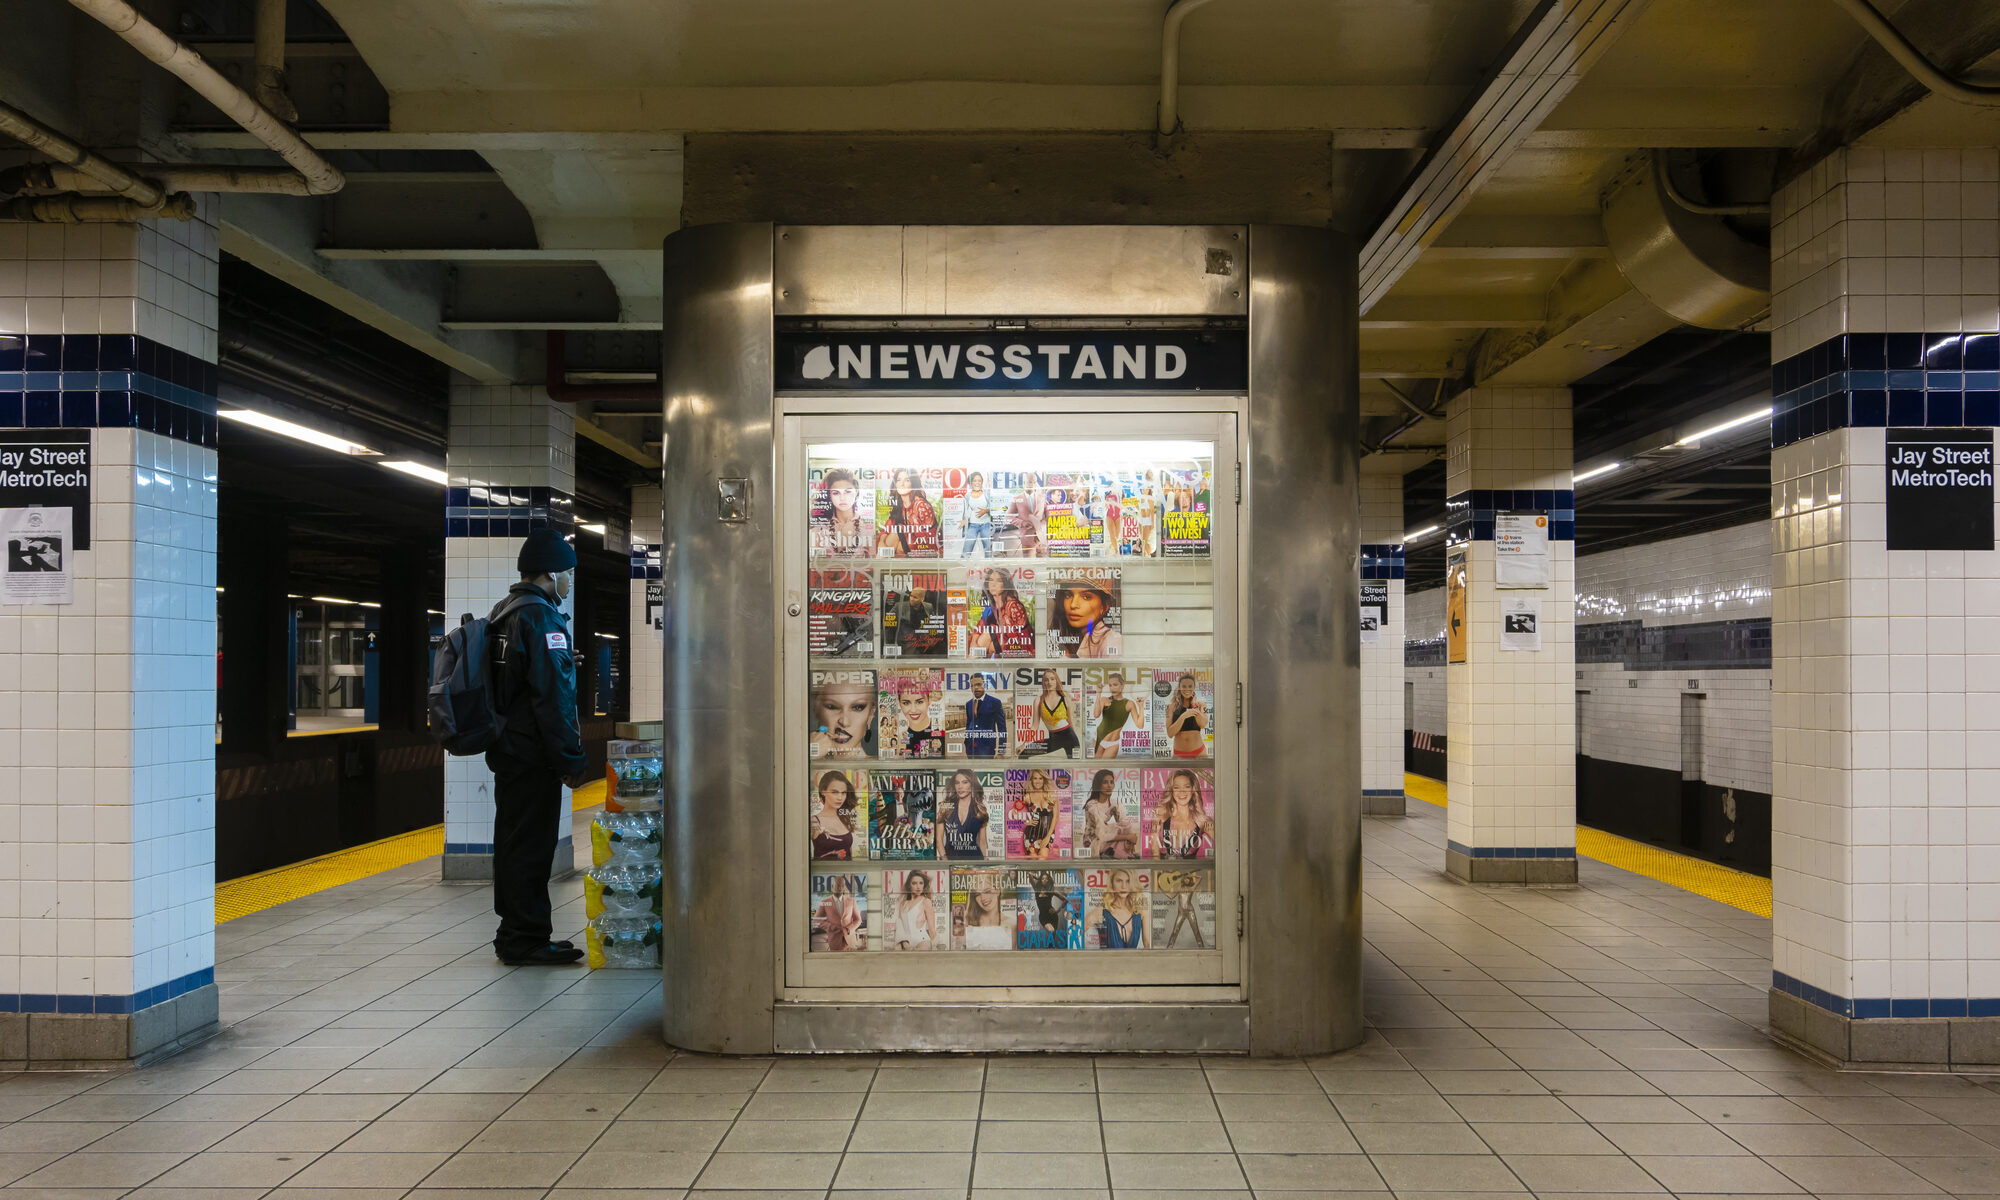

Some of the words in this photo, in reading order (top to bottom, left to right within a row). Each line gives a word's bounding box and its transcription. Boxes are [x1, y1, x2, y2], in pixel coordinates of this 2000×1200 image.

[838, 344, 1187, 380] NEWSSTAND
[0, 448, 24, 469] ay
[29, 448, 86, 465] Street
[1892, 447, 1927, 468] Jay
[1932, 447, 1990, 464] Street
[808, 468, 875, 480] Inle
[945, 468, 966, 490] O
[1892, 469, 1992, 486] MetroTech
[993, 472, 1045, 489] EBON
[878, 522, 932, 534] Summer
[1047, 516, 1076, 528] AMBER
[1163, 518, 1185, 528] TWO
[1186, 518, 1208, 528] NEW
[1122, 527, 1139, 538] LBS!
[1169, 528, 1202, 539] WIVES!
[968, 567, 1035, 580] Inyle
[1047, 567, 1085, 580] marie
[1086, 567, 1122, 579] claire
[648, 586, 661, 595] Jay
[811, 591, 872, 603] KINGPINS
[815, 603, 871, 614] KILLERS
[972, 623, 1025, 634] Summer
[812, 671, 874, 685] PAPER
[946, 672, 1011, 690] EBNY
[1017, 705, 1032, 717] RUN
[1017, 717, 1031, 729] THE
[1017, 730, 1045, 742] WORLD
[914, 744, 920, 753] 2
[1121, 739, 1135, 747] BODY
[1136, 739, 1151, 747] EVER!
[1155, 750, 1171, 758] WAIST
[909, 775, 935, 791] FAIR
[938, 773, 1003, 786] Inyle
[881, 823, 921, 838] BILL
[949, 833, 973, 841] HAIR
[1145, 835, 1213, 848] FASHION
[954, 875, 985, 889] BARELY
[991, 874, 1017, 889] LEGAL
